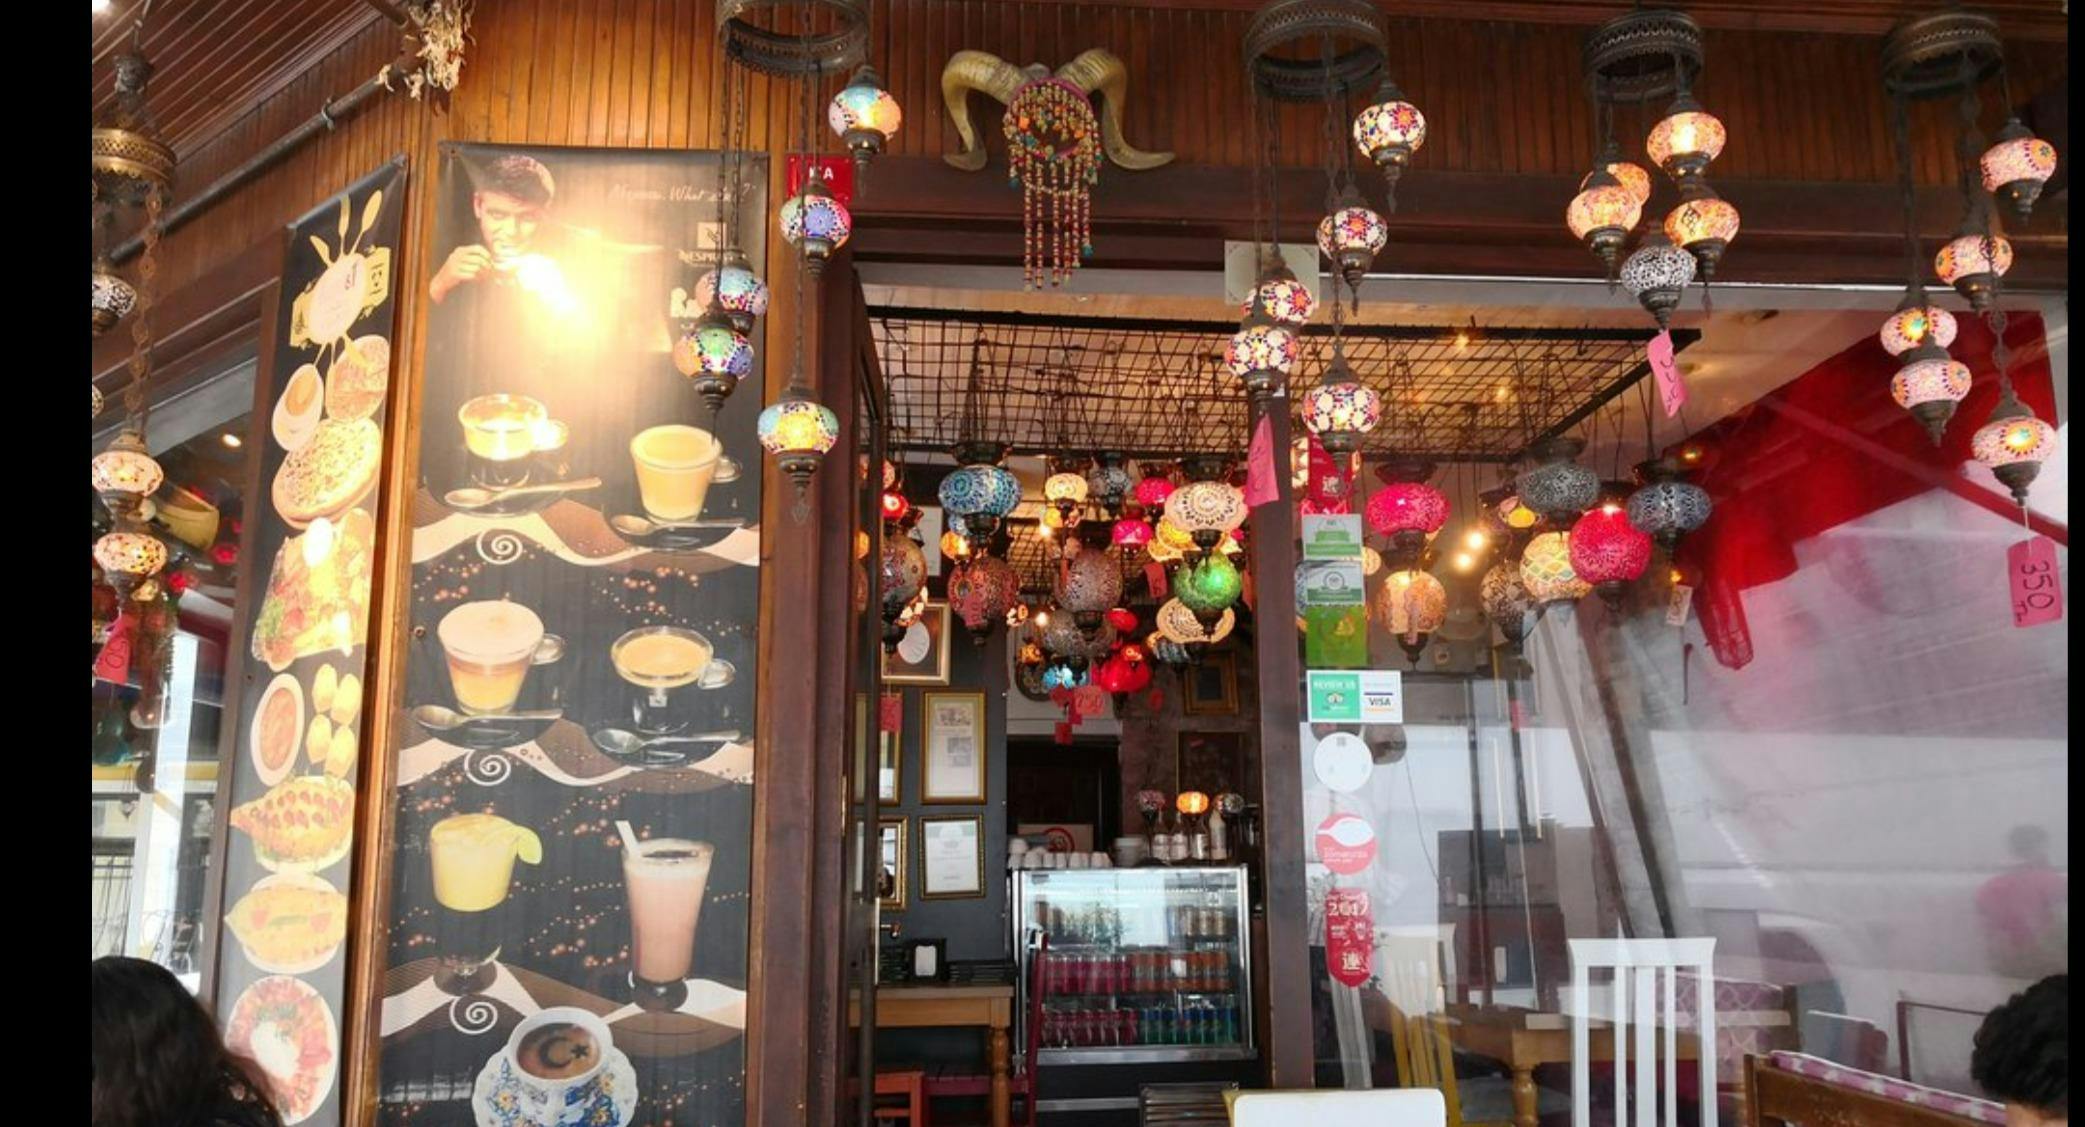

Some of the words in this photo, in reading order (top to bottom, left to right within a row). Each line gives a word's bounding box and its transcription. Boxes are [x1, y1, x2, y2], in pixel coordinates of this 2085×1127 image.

[670, 183, 704, 201] What
[2021, 560, 2055, 609] 350
[1368, 697, 1391, 706] VISA
